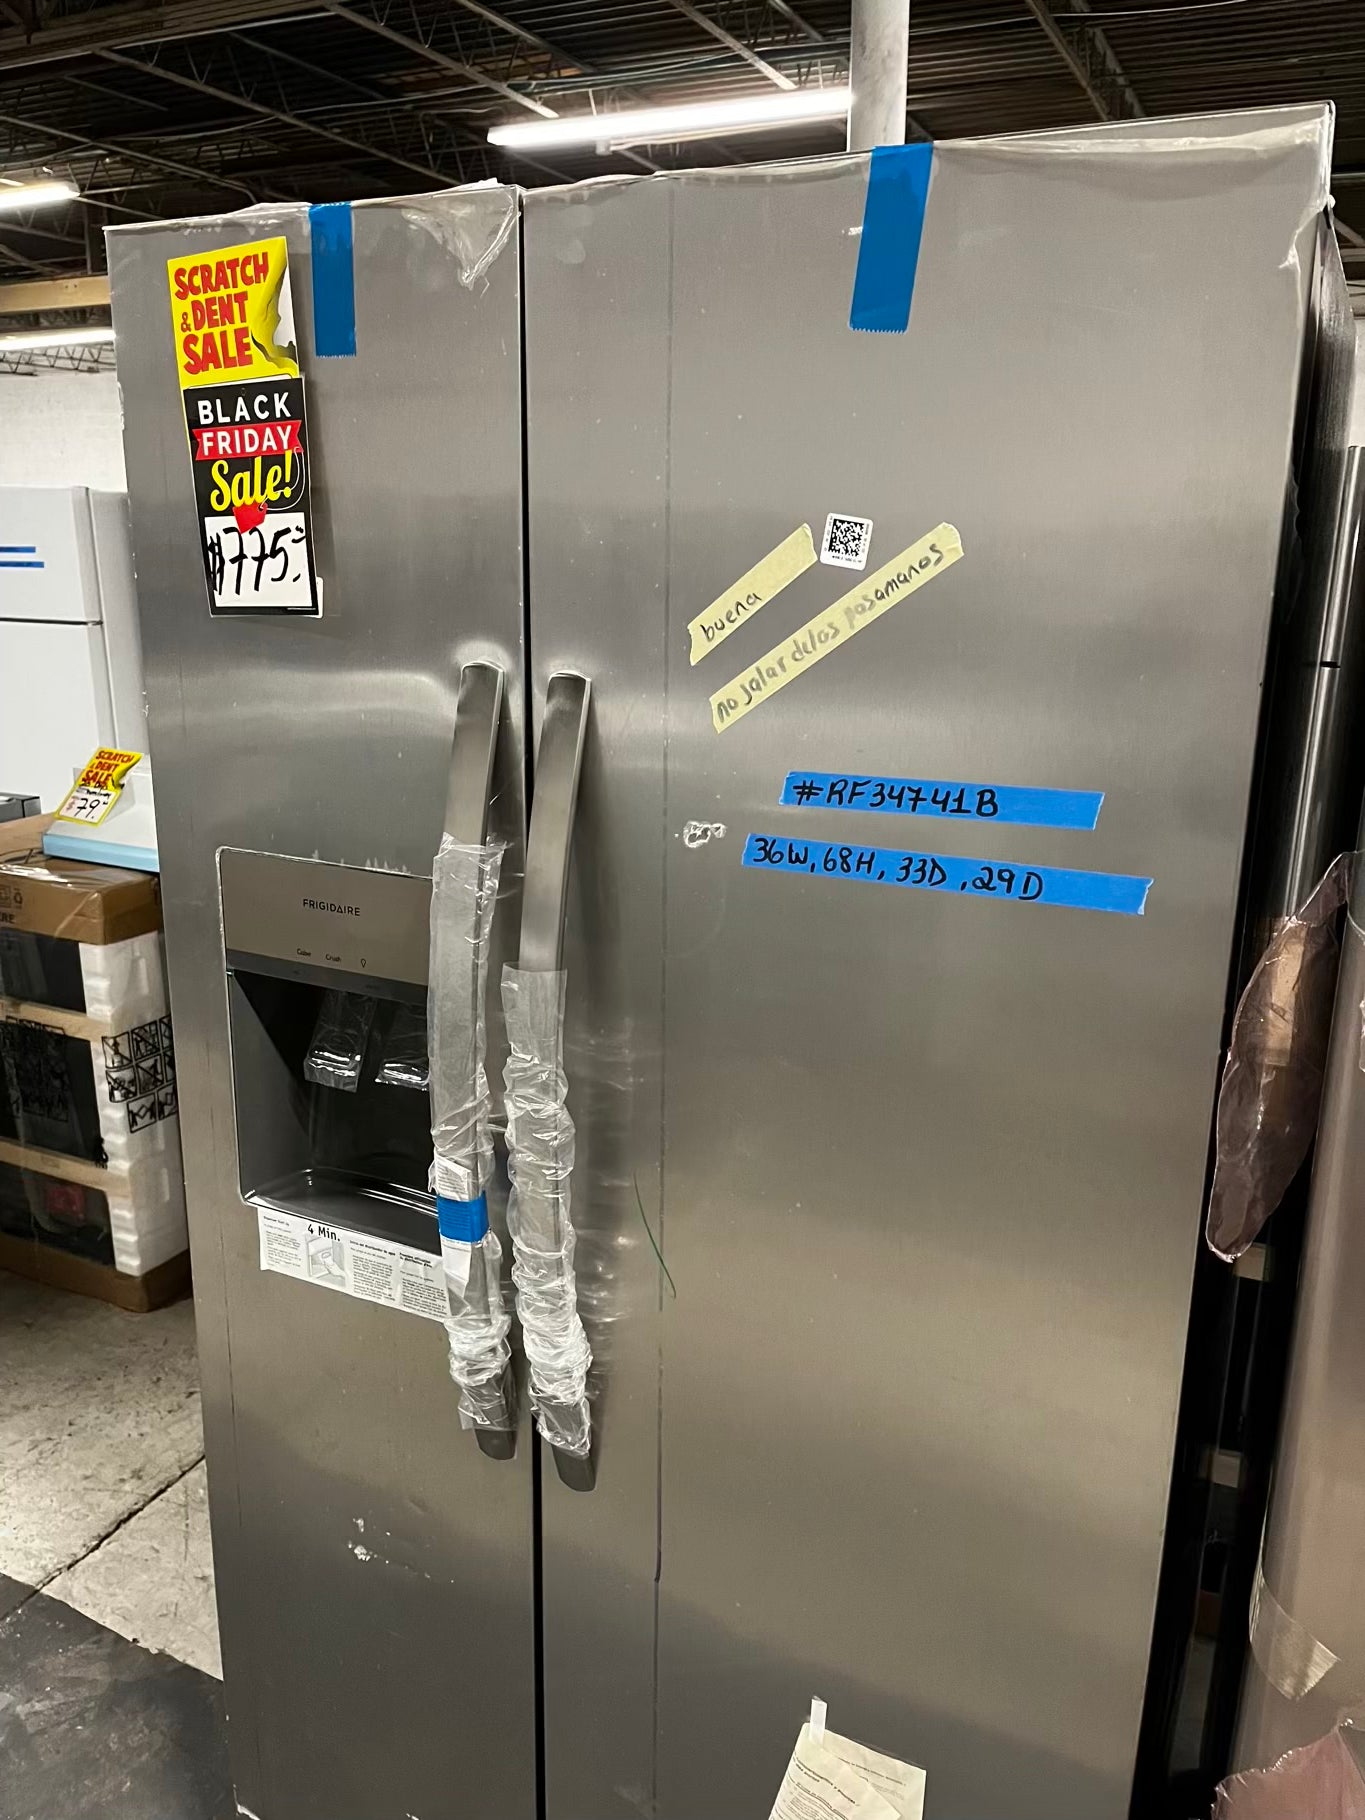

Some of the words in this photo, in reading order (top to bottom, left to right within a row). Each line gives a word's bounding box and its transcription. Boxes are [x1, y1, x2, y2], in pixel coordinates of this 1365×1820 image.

[174, 252, 270, 301] SCRATCH
[180, 311, 192, 332] &
[191, 291, 249, 331] DENT
[183, 327, 254, 375] SALE
[197, 391, 292, 425] BLACK
[201, 424, 293, 456] FRIDAY
[210, 449, 293, 512] Sale!
[700, 591, 763, 643] buena
[716, 697, 738, 724] no
[793, 778, 998, 818] #RF34741B
[302, 898, 361, 917] FRIGIDAIRE
[308, 1223, 315, 1235] 4
[318, 1225, 341, 1242] Min.
